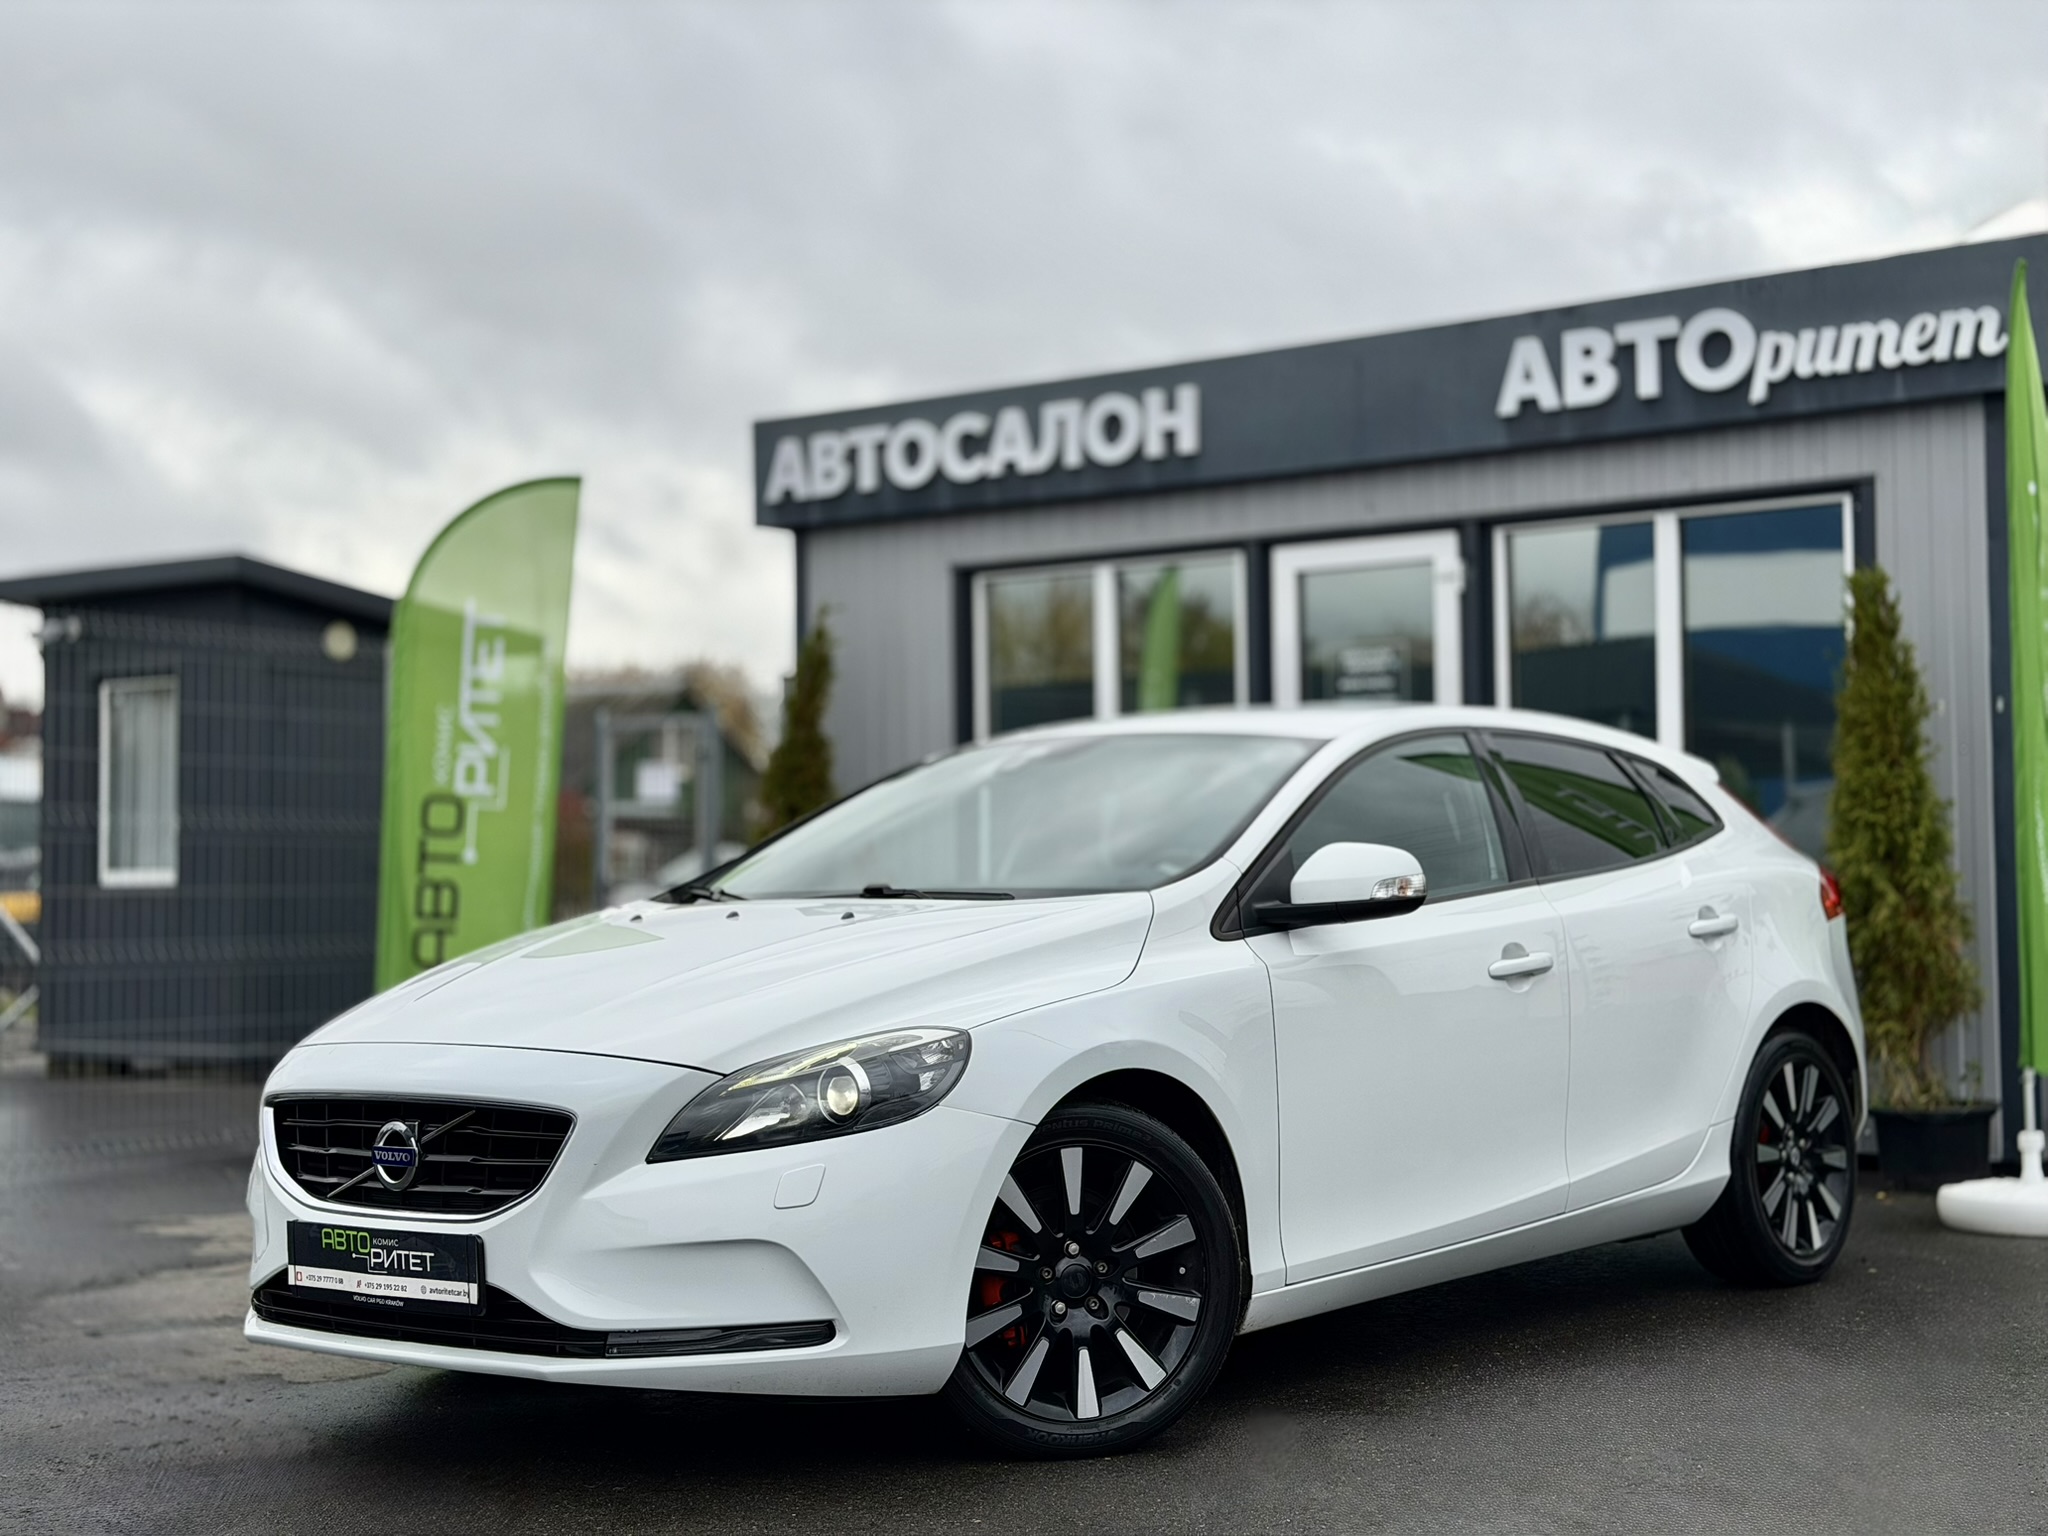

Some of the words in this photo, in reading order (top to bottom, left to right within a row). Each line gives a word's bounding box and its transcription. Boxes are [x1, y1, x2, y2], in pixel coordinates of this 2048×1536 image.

[763, 382, 1201, 505] АВТОСАЛОН
[451, 598, 505, 797] РИТЕТ
[410, 791, 466, 970] АВТО
[373, 1150, 411, 1162] VOLVO
[321, 1228, 370, 1253] АВТО
[372, 1237, 400, 1247] КОМИС
[370, 1248, 435, 1272] РИТЕТ
[364, 1282, 375, 1290] +375
[383, 1283, 393, 1291] 195
[393, 1284, 400, 1292] 22
[367, 1296, 375, 1304] CAR
